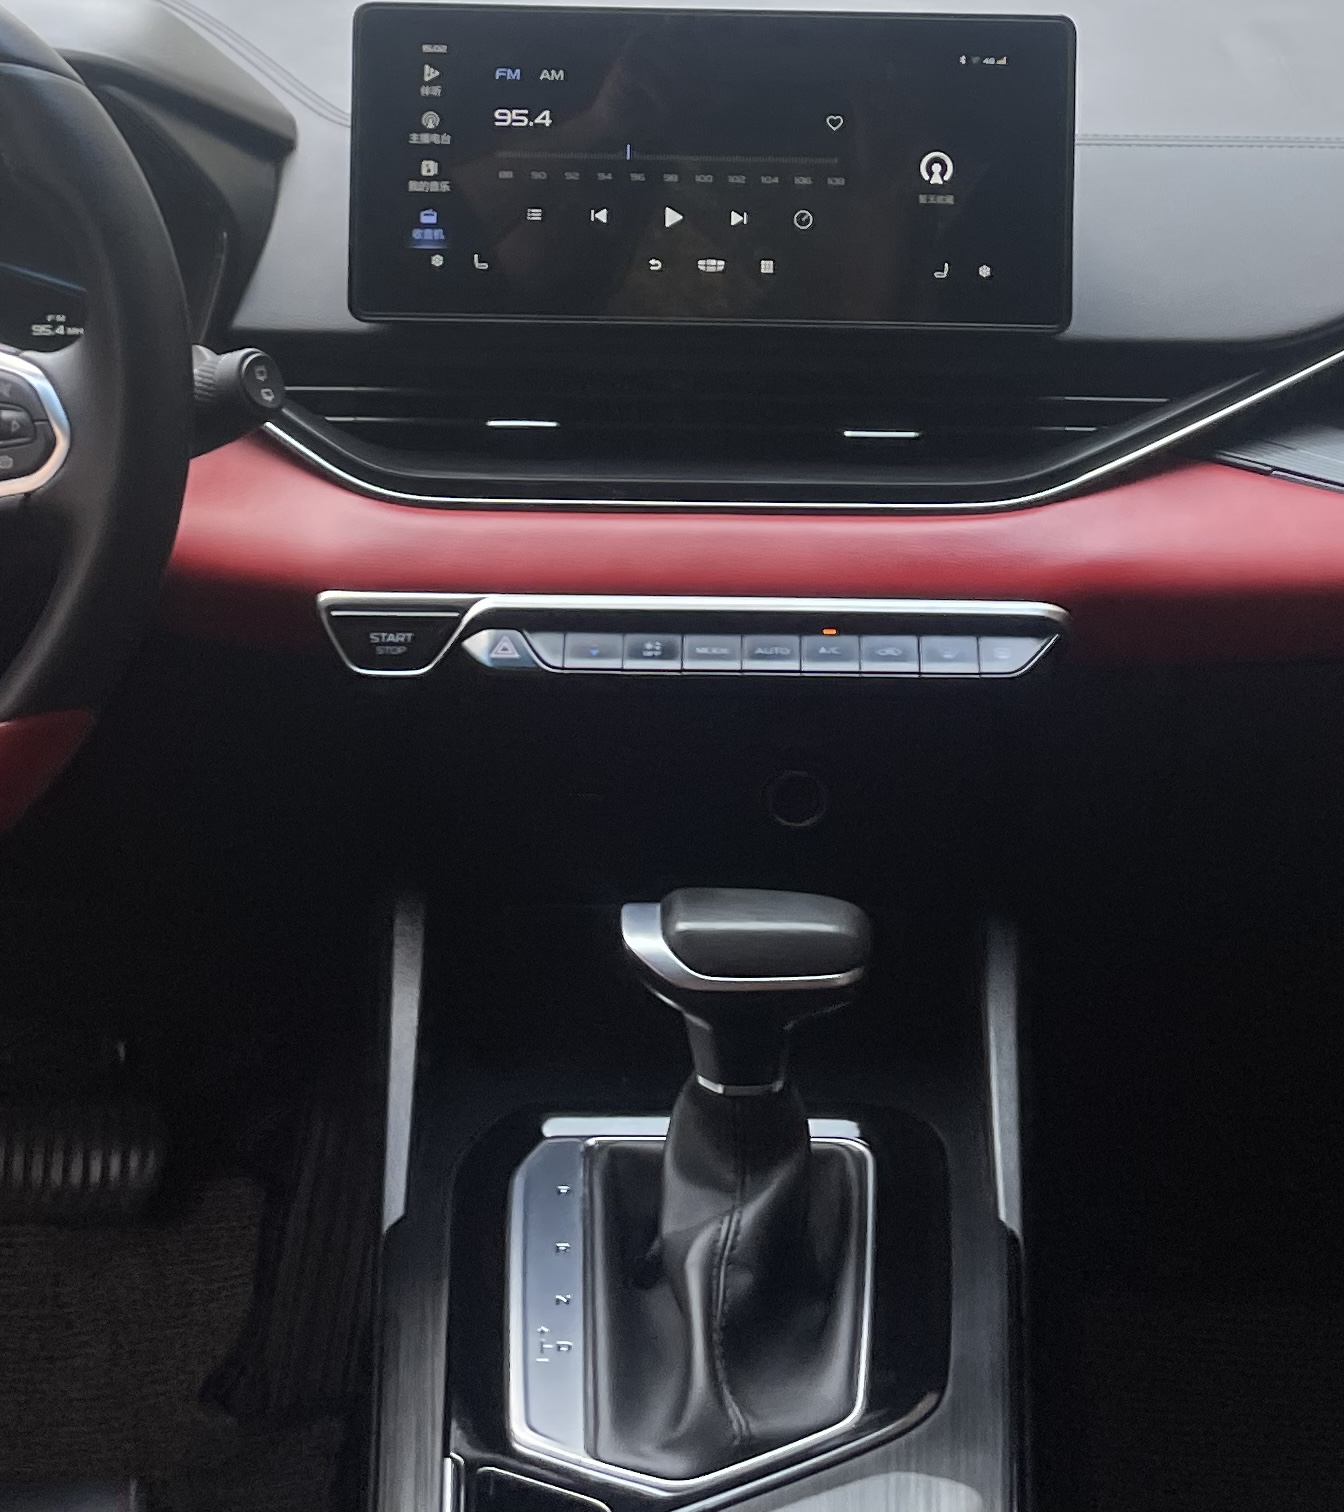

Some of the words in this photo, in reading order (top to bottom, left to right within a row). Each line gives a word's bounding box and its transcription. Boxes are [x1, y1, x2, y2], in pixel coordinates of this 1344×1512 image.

[495, 67, 521, 80] FM
[539, 68, 565, 81] AM
[493, 108, 553, 127] 95.4
[695, 174, 713, 183] 100
[728, 175, 746, 184] 102
[760, 175, 779, 184] 104
[31, 324, 65, 336] 95.4
[369, 632, 414, 643] START
[376, 646, 408, 655] STOP
[754, 646, 791, 655] AUTO
[818, 646, 841, 655] A/C
